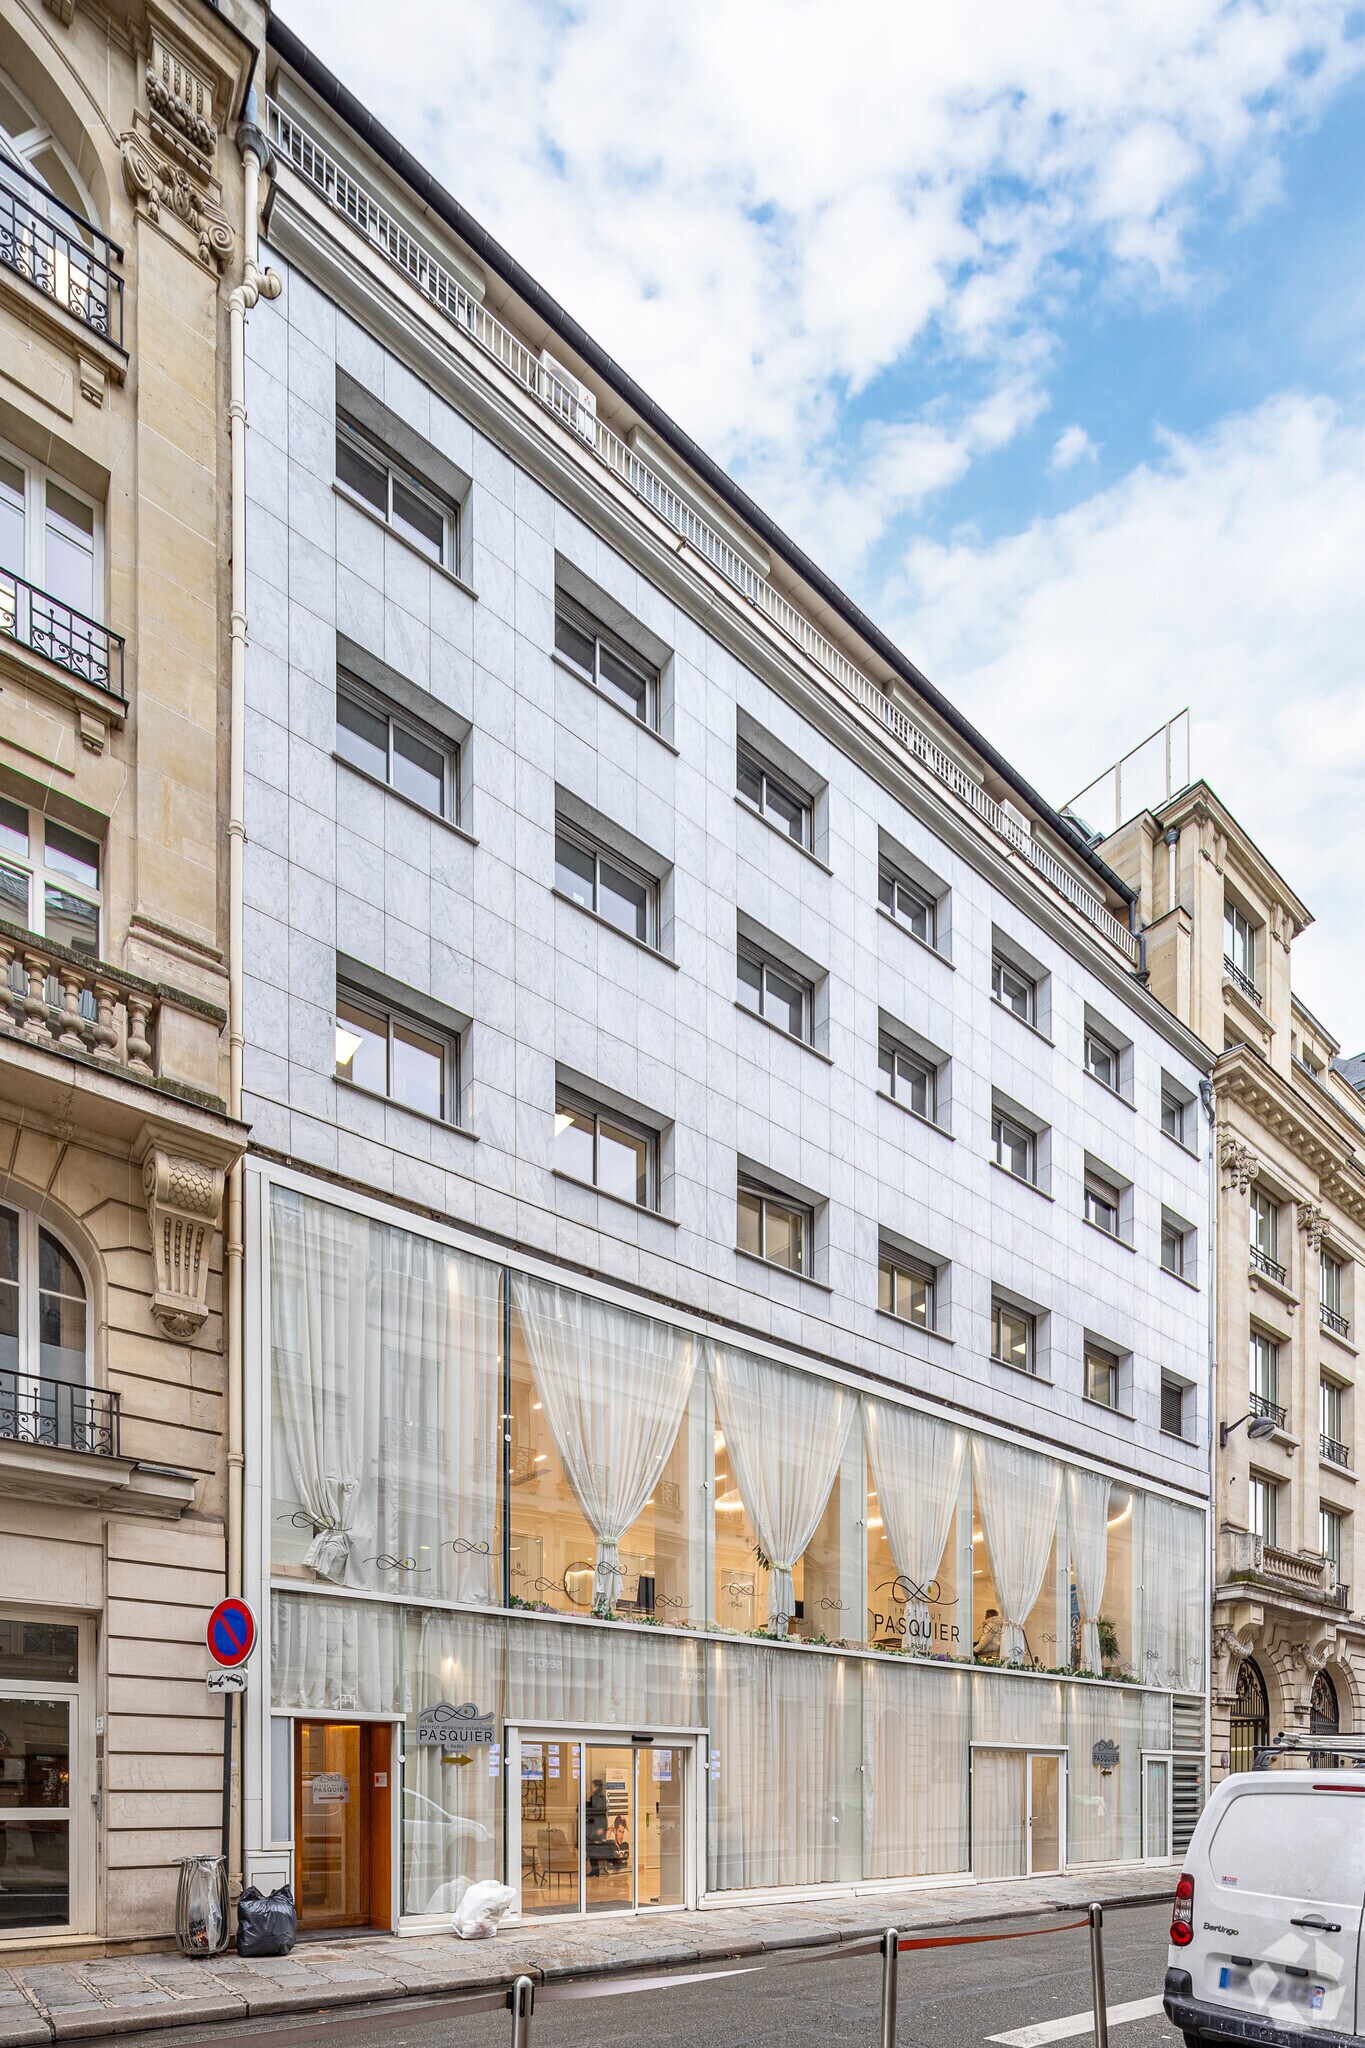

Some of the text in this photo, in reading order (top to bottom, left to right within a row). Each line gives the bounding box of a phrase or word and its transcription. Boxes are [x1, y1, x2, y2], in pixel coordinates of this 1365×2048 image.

[894, 1607, 942, 1621] INSTITUT
[874, 1613, 960, 1643] PASQUIER
[419, 1729, 493, 1743] PASQUIER
[1093, 1754, 1120, 1763] PASQUIER
[1203, 1921, 1239, 1936] Berlingo
